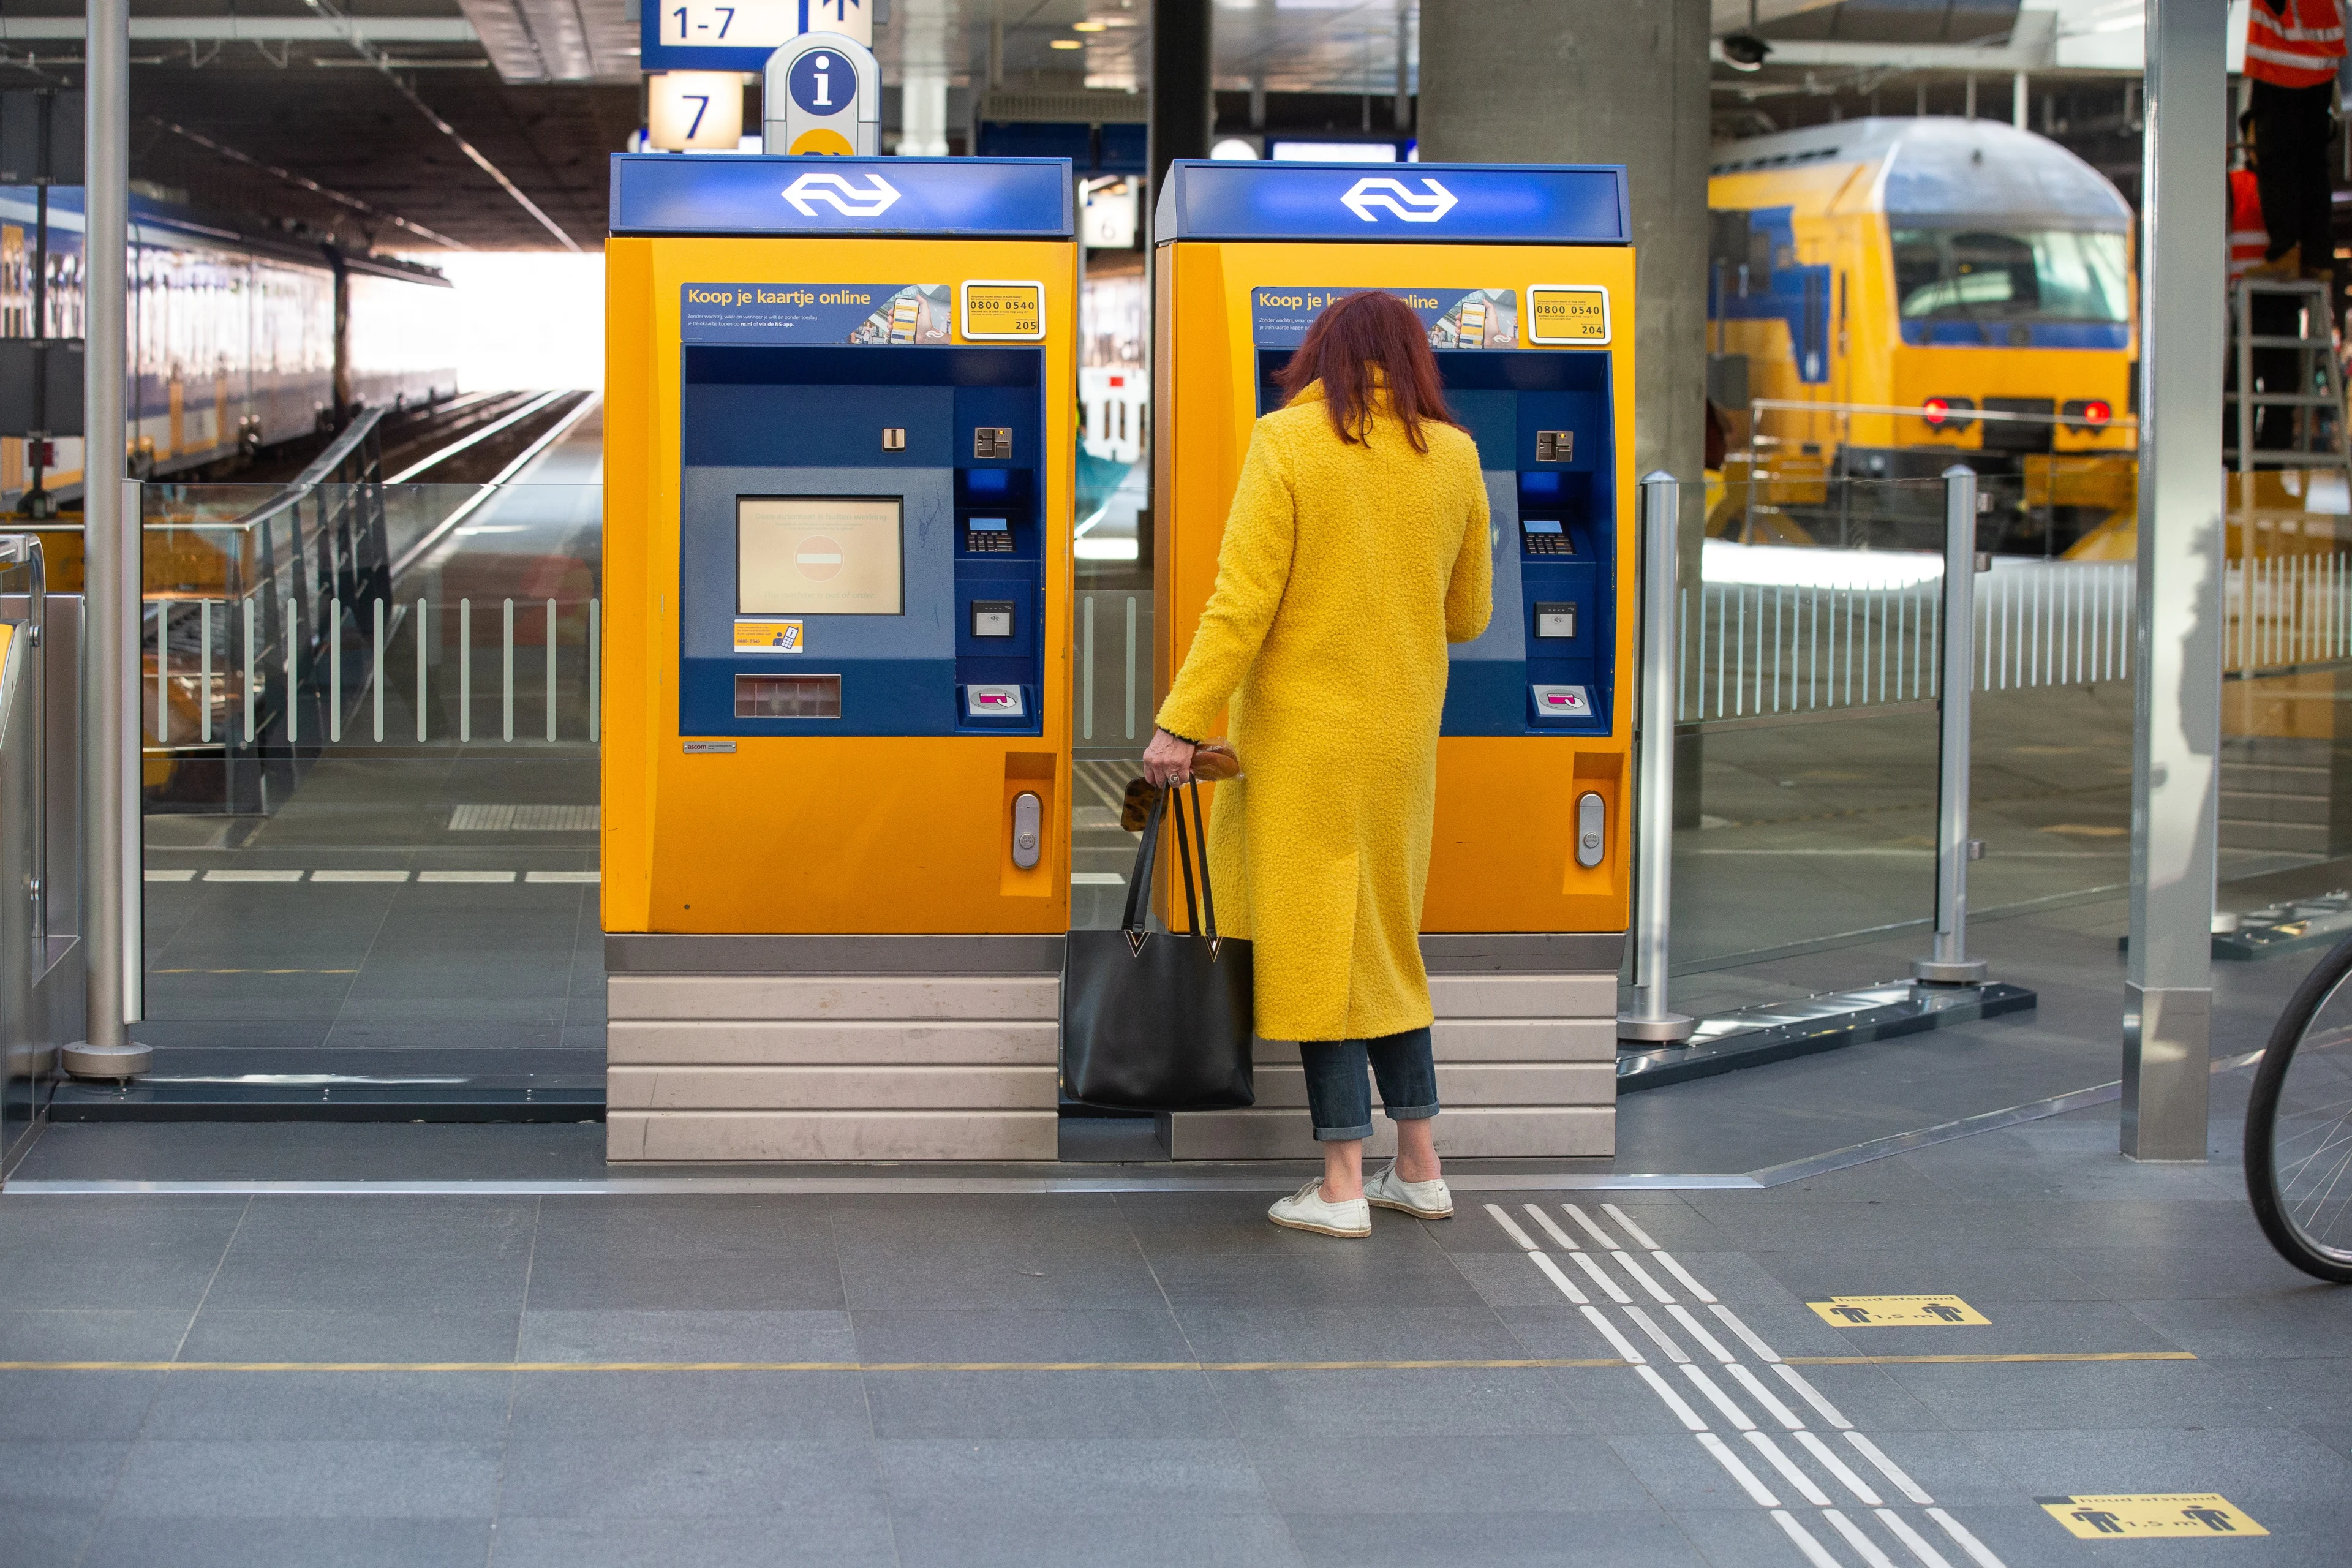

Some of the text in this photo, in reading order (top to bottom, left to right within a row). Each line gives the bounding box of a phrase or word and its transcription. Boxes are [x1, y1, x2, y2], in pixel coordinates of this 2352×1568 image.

[673, 7, 735, 38] 1-7
[813, 56, 832, 105] i
[682, 96, 709, 139] 7
[1101, 217, 1116, 241] 6
[688, 289, 870, 307] Koop je kaartje online
[1259, 293, 1302, 310] Koop
[1306, 293, 1322, 311] je
[1388, 295, 1438, 309] line
[854, 513, 889, 522] werking.
